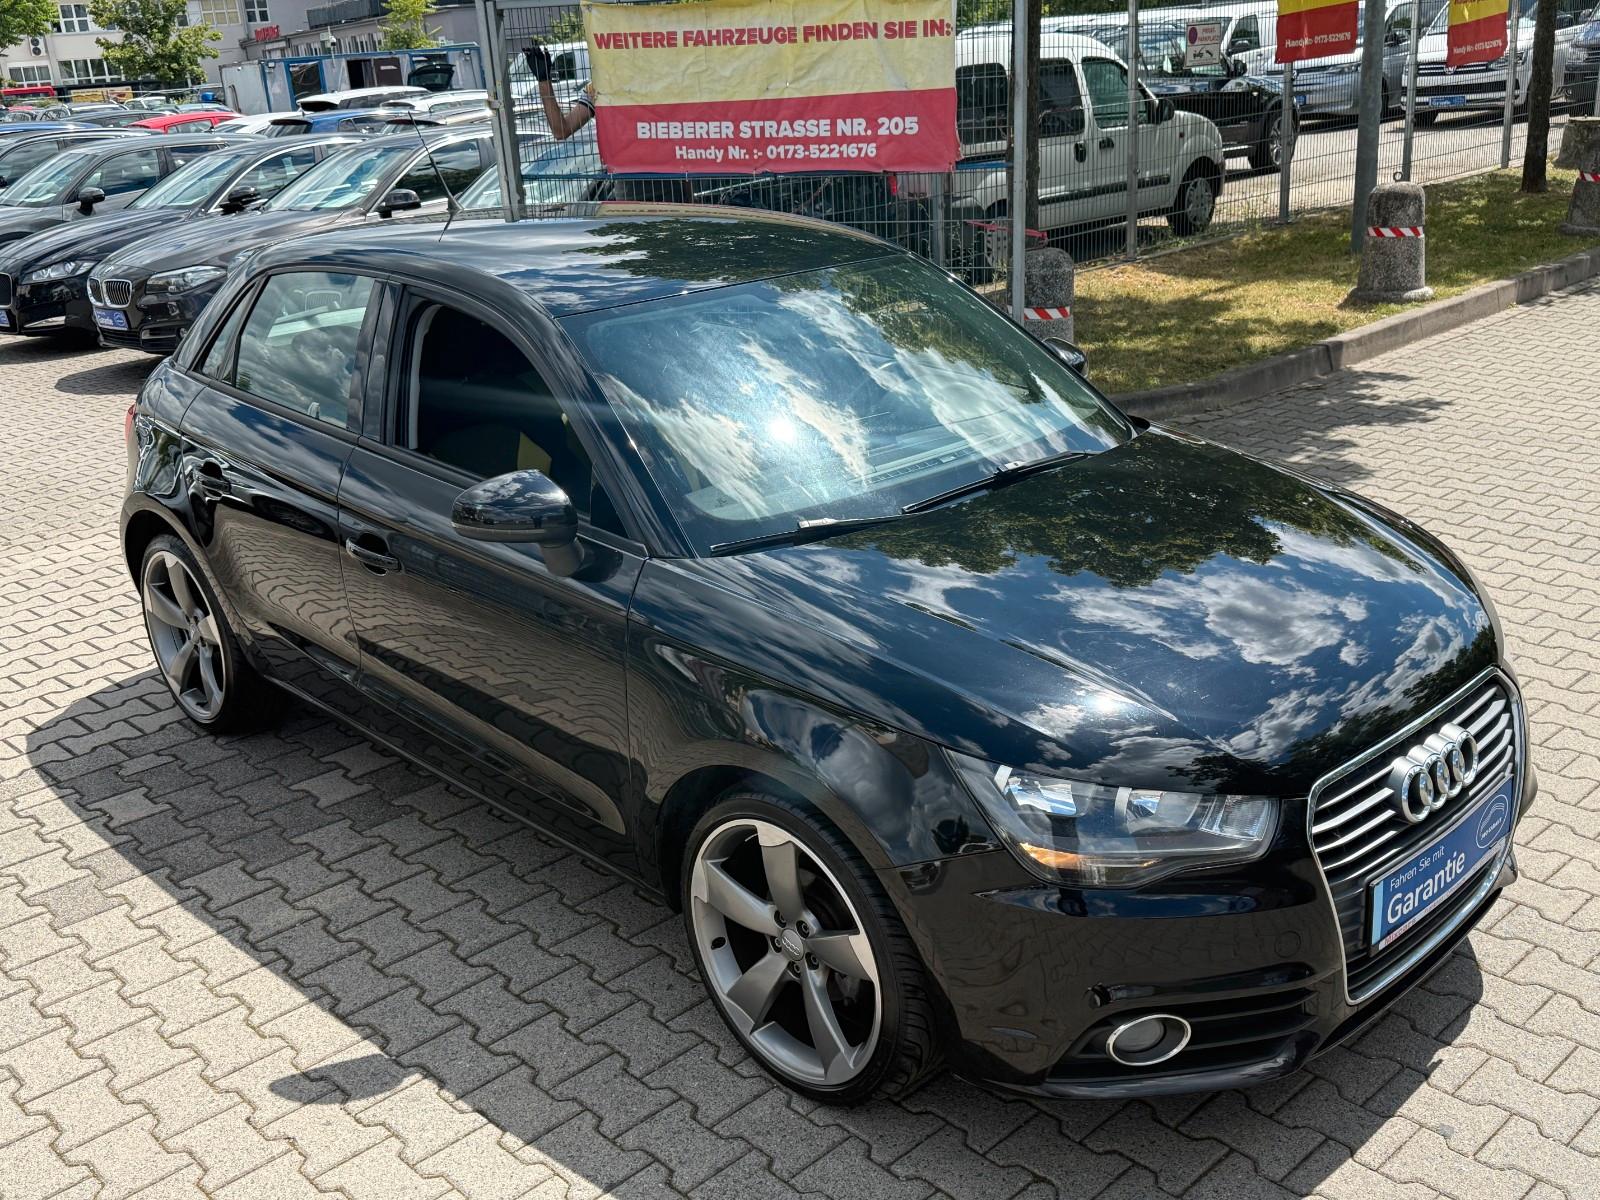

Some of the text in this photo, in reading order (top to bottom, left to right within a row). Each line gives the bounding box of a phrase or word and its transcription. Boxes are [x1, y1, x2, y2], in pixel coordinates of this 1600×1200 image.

[594, 31, 678, 50] WEITERE
[682, 26, 798, 48] FAHRZEUGE
[803, 22, 878, 43] FINDEN
[884, 20, 918, 39] SIE
[637, 116, 919, 140] BIEBERER STRASSE NR. 205
[675, 145, 724, 163] Handy
[727, 146, 749, 159] Nr.
[767, 142, 877, 159] 0173-5221676
[1390, 845, 1445, 892] Fahren Sie mit
[1387, 851, 1466, 924] Garantie
